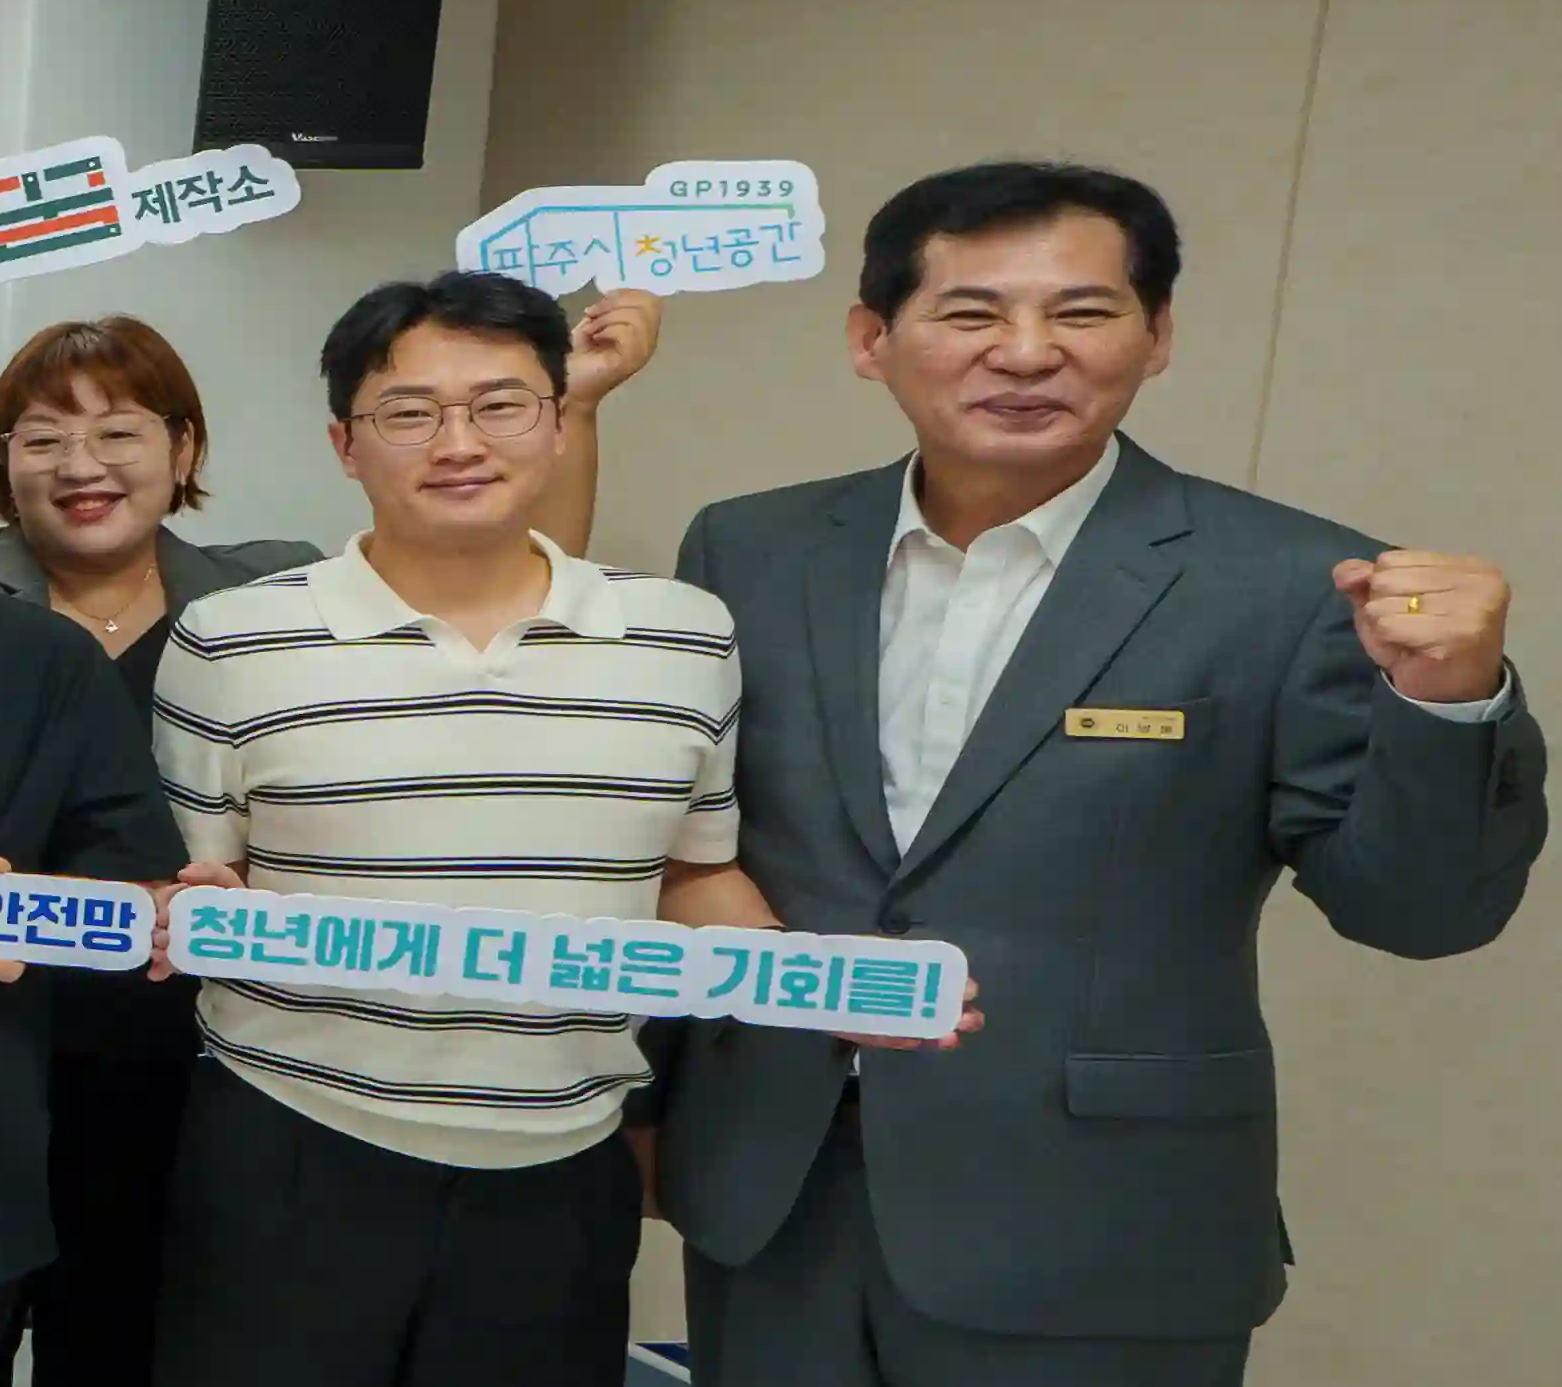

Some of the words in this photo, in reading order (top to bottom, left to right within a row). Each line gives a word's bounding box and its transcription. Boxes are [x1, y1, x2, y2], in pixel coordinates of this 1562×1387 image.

[131, 165, 276, 225] 제작소
[669, 180, 795, 198] GP1939
[188, 905, 442, 978] 청년에게
[462, 928, 528, 986] 더
[549, 935, 683, 999] 넓은
[706, 945, 941, 1020] 기회를!
